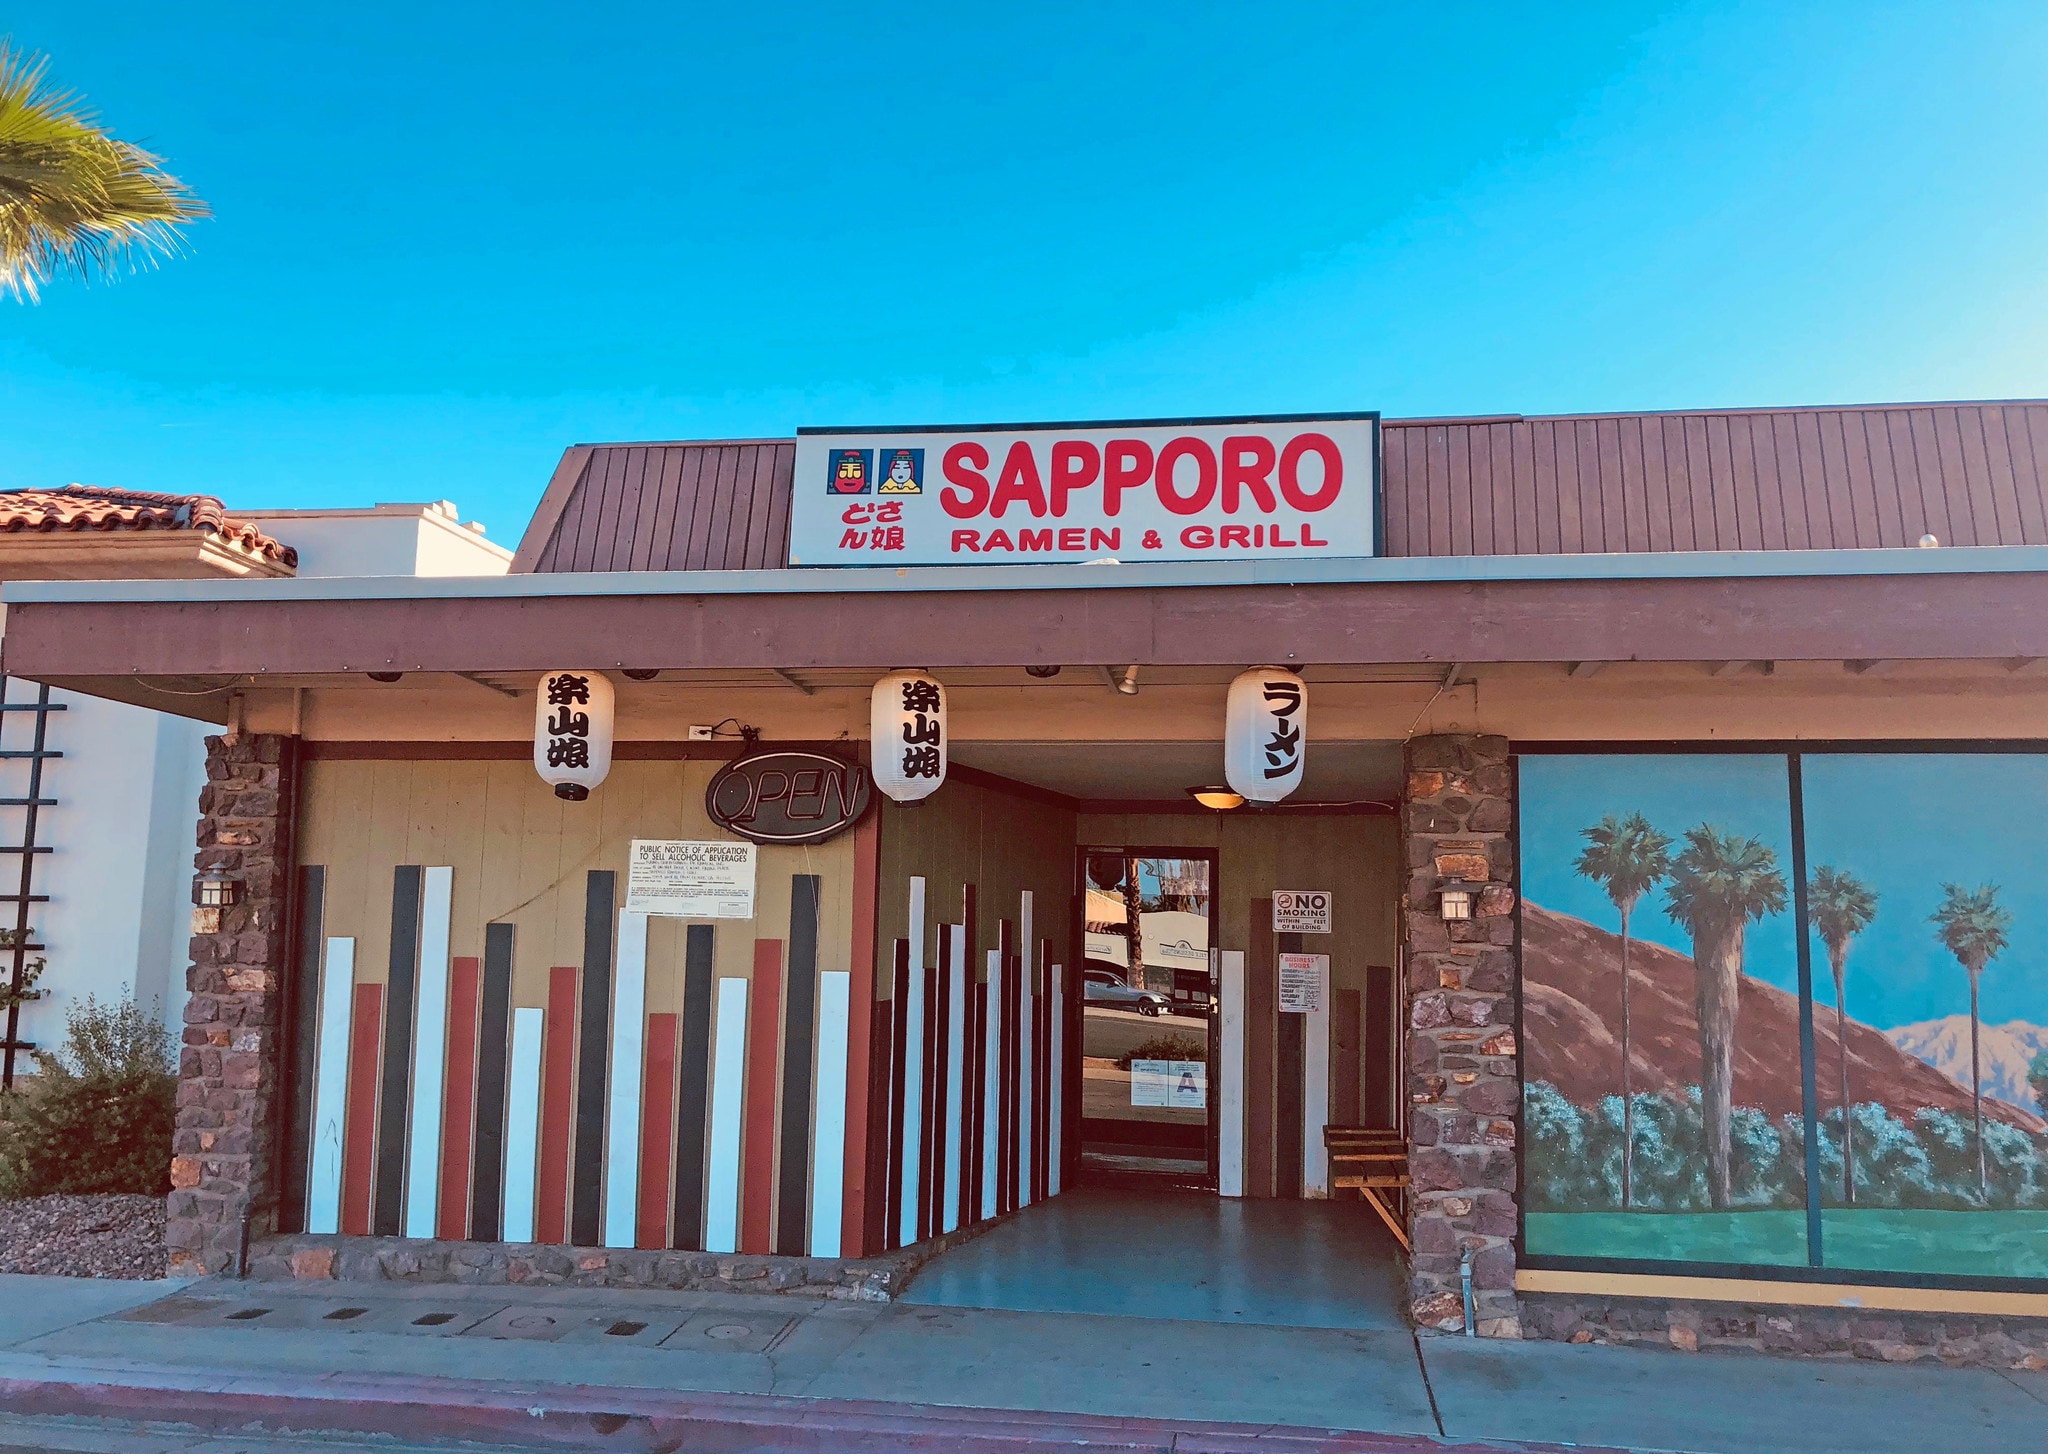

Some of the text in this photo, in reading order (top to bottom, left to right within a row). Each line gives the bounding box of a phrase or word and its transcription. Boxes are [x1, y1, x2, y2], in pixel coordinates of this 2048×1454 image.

[940, 433, 1343, 519] SAPPORO
[951, 523, 1329, 553] RAMEN & GRILL
[1263, 682, 1301, 780] ラーメン
[712, 770, 861, 820] OPEN
[639, 845, 661, 853] PUBLIC
[704, 847, 748, 855] APPLICATION
[668, 854, 706, 862] ALCOHOLIC
[709, 855, 747, 863] BEVERAGES
[1295, 895, 1326, 909] NO
[1277, 909, 1326, 917] SMOKING
[1177, 1072, 1198, 1093] A
